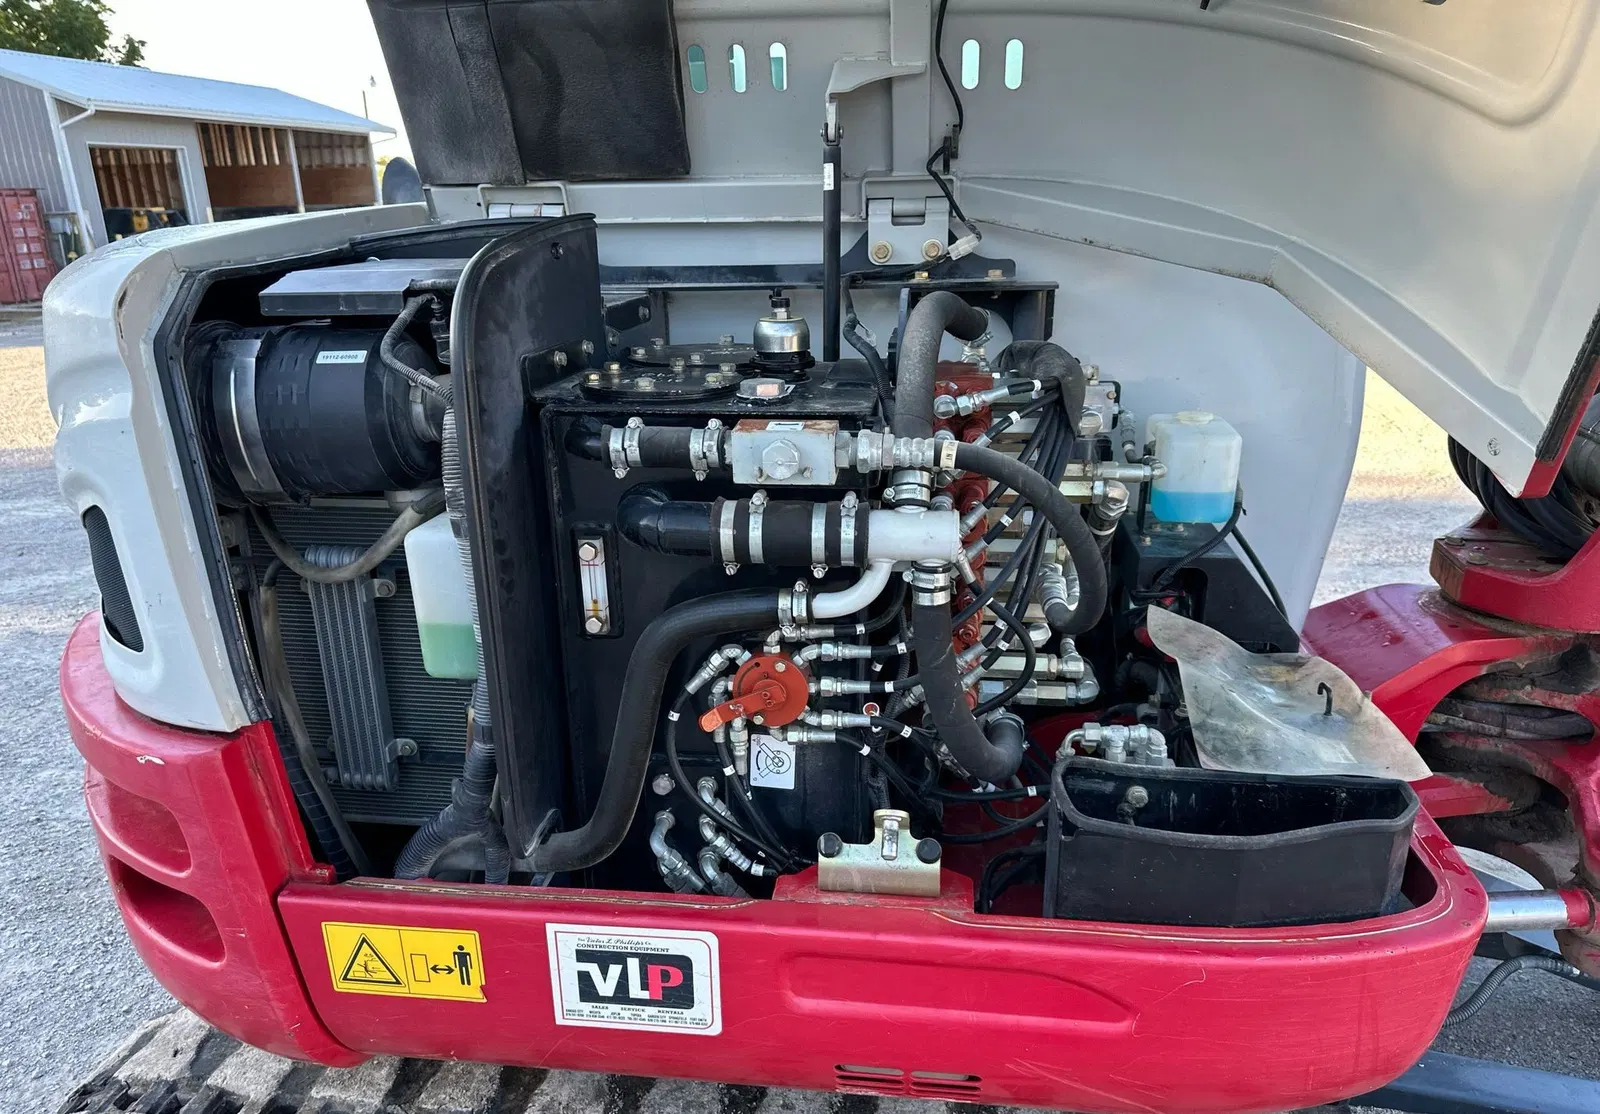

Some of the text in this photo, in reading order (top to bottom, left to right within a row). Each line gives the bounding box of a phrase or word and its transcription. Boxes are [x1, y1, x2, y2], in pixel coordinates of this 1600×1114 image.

[586, 936, 605, 944] Victor
[613, 937, 644, 946] Phillips
[576, 943, 629, 951] CONSTRUCTION
[576, 957, 684, 1000] VLP
